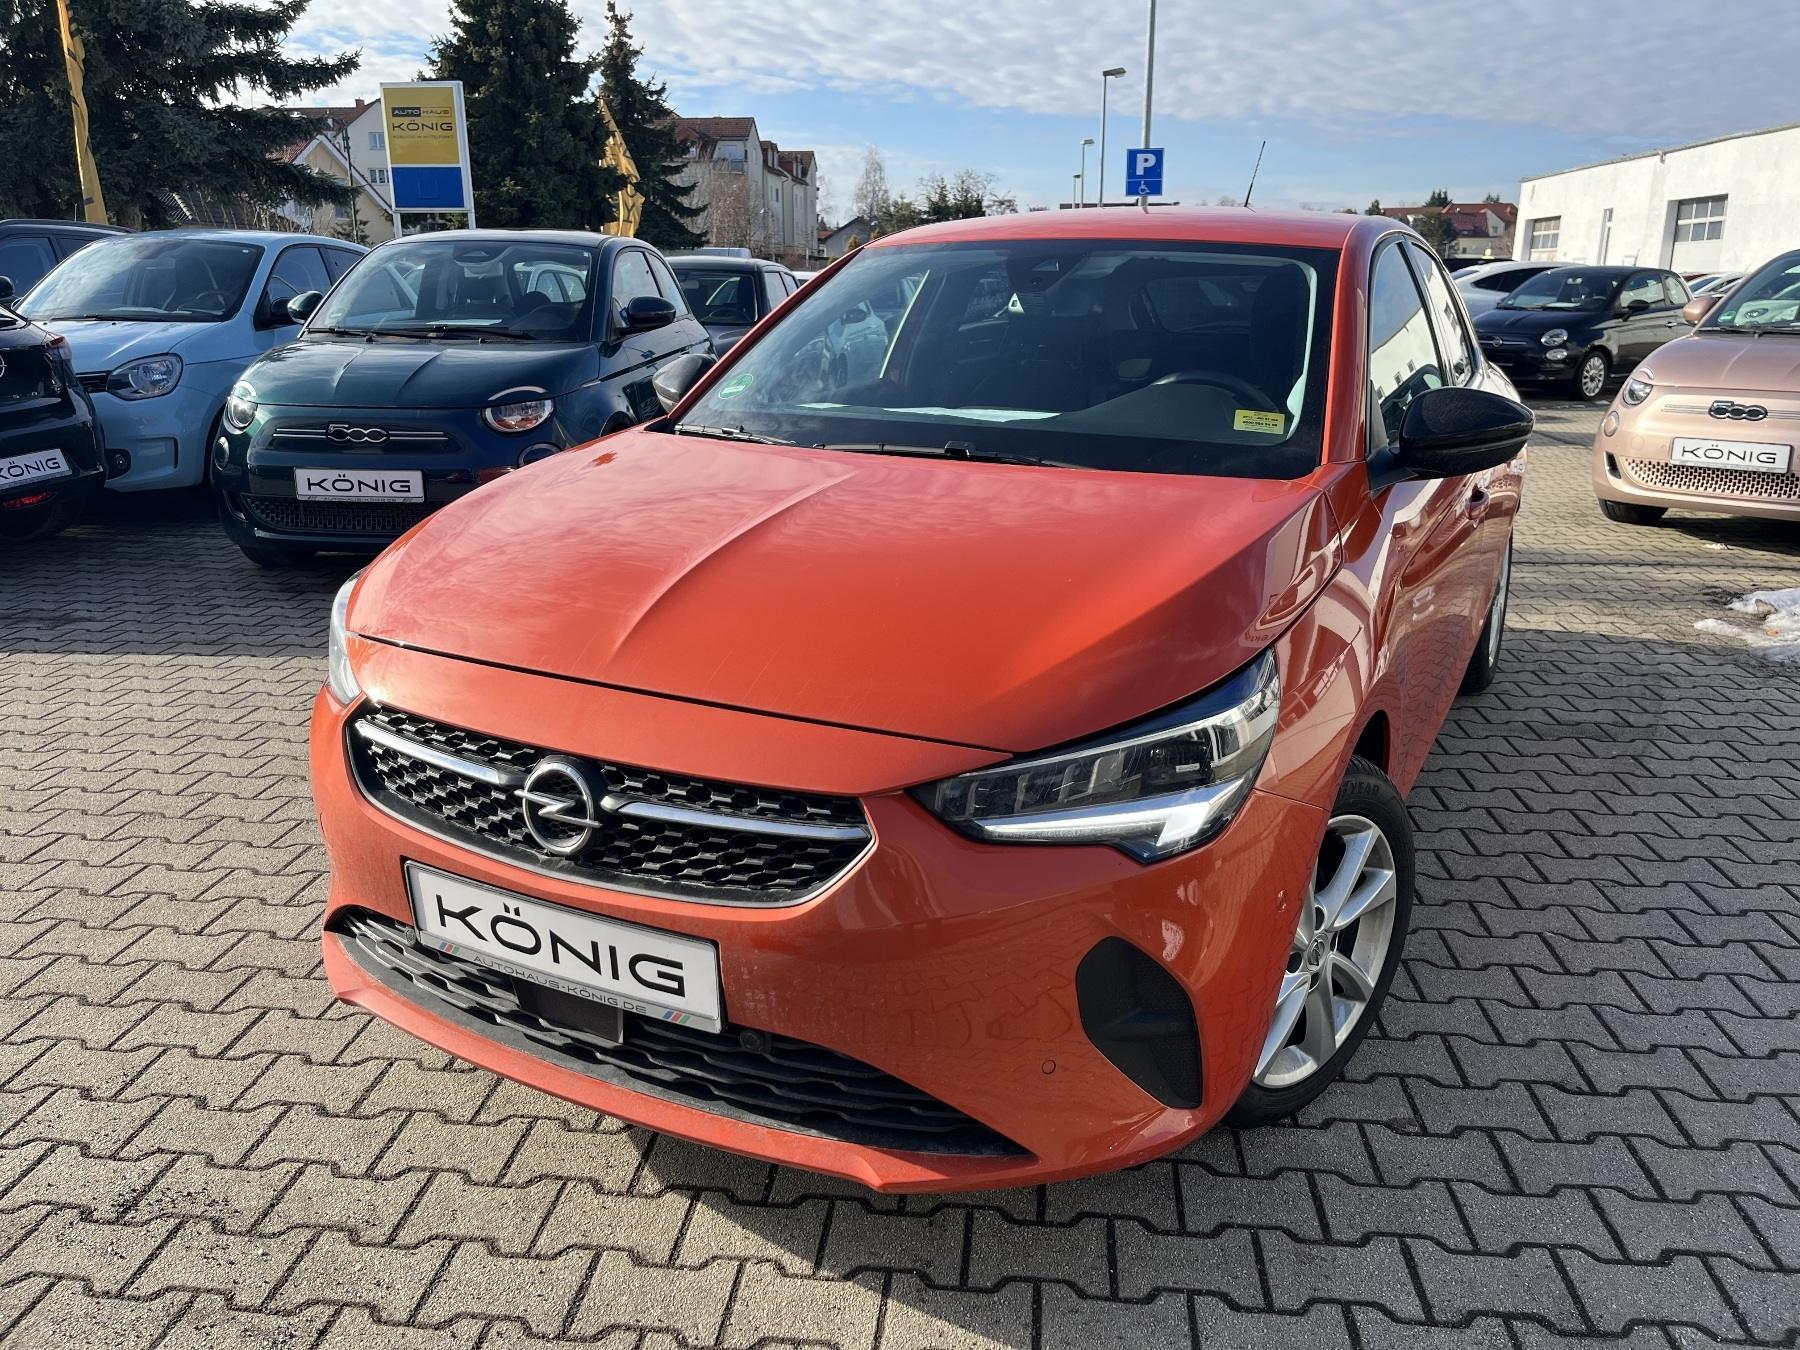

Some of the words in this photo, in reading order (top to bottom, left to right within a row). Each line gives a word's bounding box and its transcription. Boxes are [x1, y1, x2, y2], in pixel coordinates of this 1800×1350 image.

[392, 119, 453, 132] KÖNIG
[1136, 153, 1157, 176] P
[1709, 400, 1768, 421] 500
[327, 423, 388, 443] 500
[1682, 443, 1777, 464] KÖNIG
[307, 473, 411, 493] KÖNIG
[436, 894, 686, 998] KÖNIG
